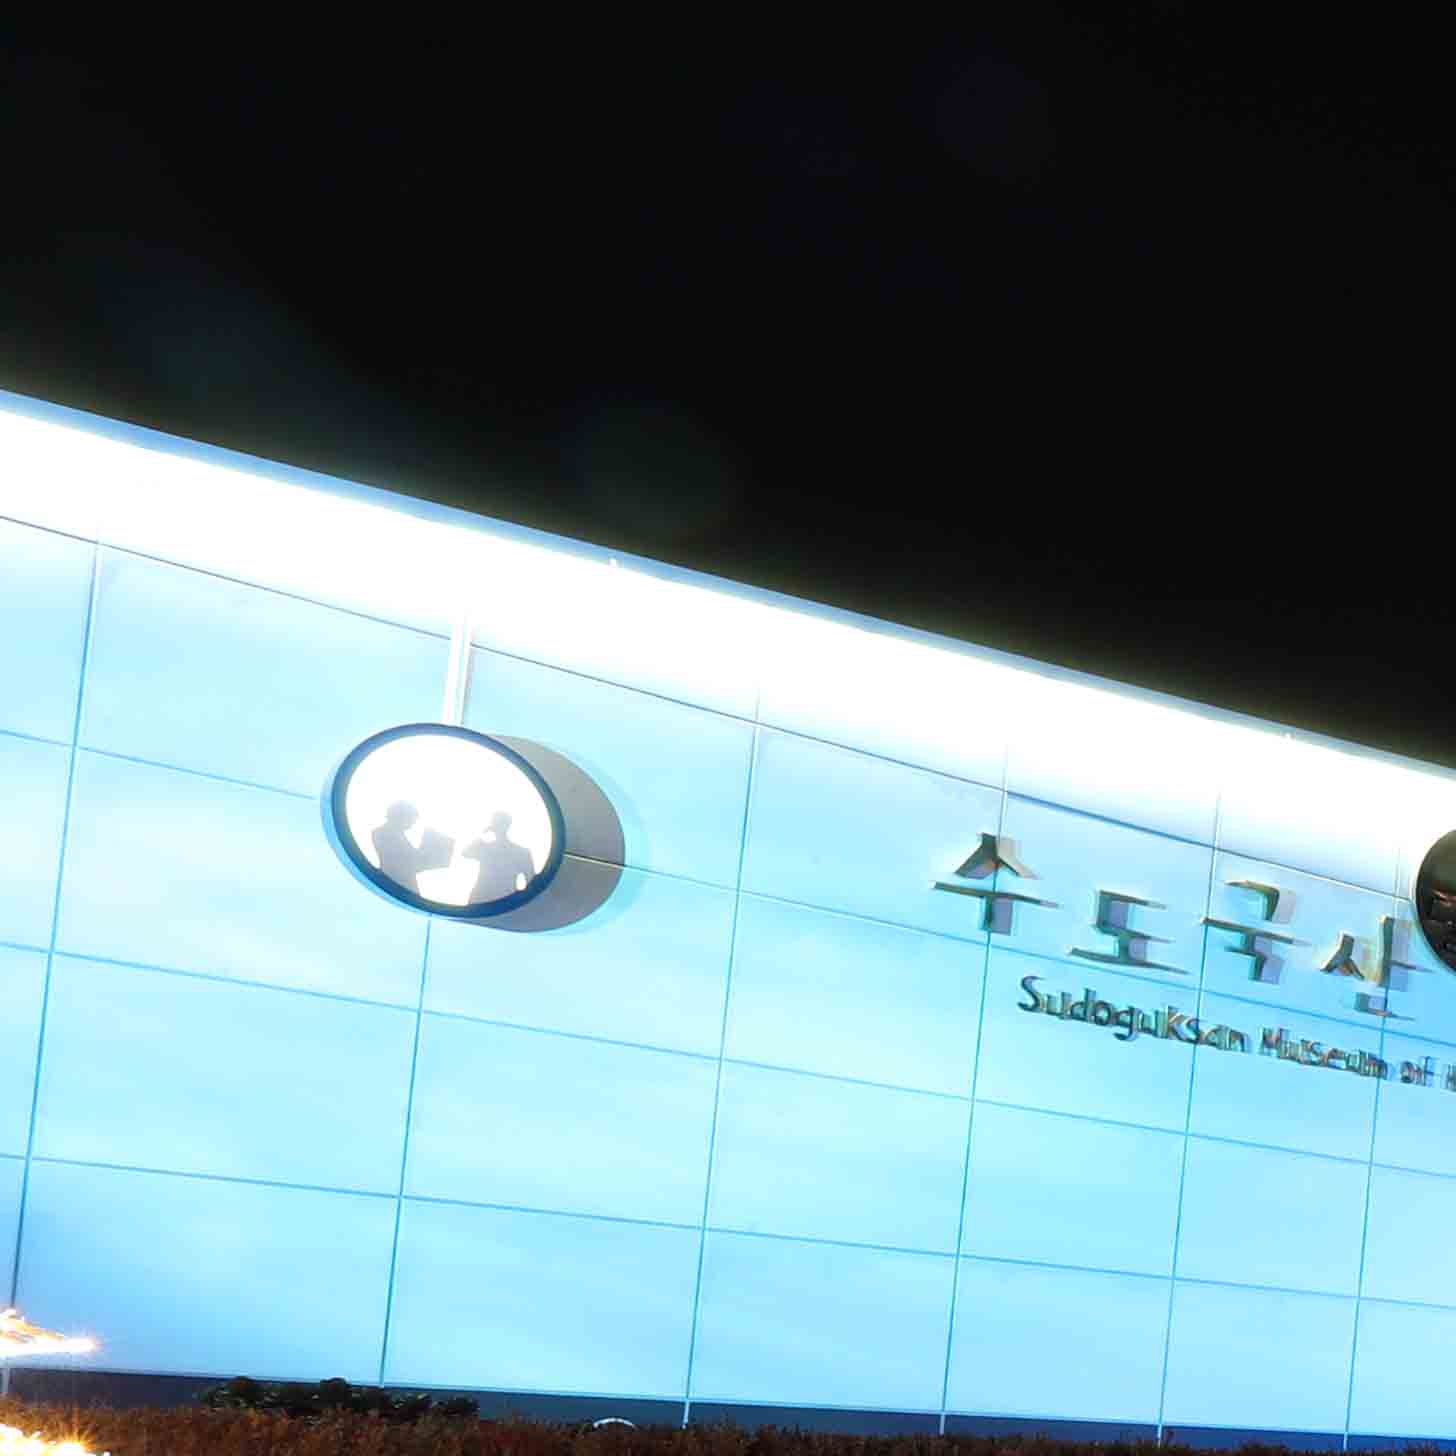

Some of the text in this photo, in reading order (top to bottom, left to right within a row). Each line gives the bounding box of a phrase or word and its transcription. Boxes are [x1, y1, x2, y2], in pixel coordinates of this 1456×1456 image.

[931, 833, 1430, 1021] 수도국산
[1017, 975, 1250, 1053] Sudoguksan
[1259, 1025, 1391, 1079] Museum
[1399, 1055, 1434, 1086] of
